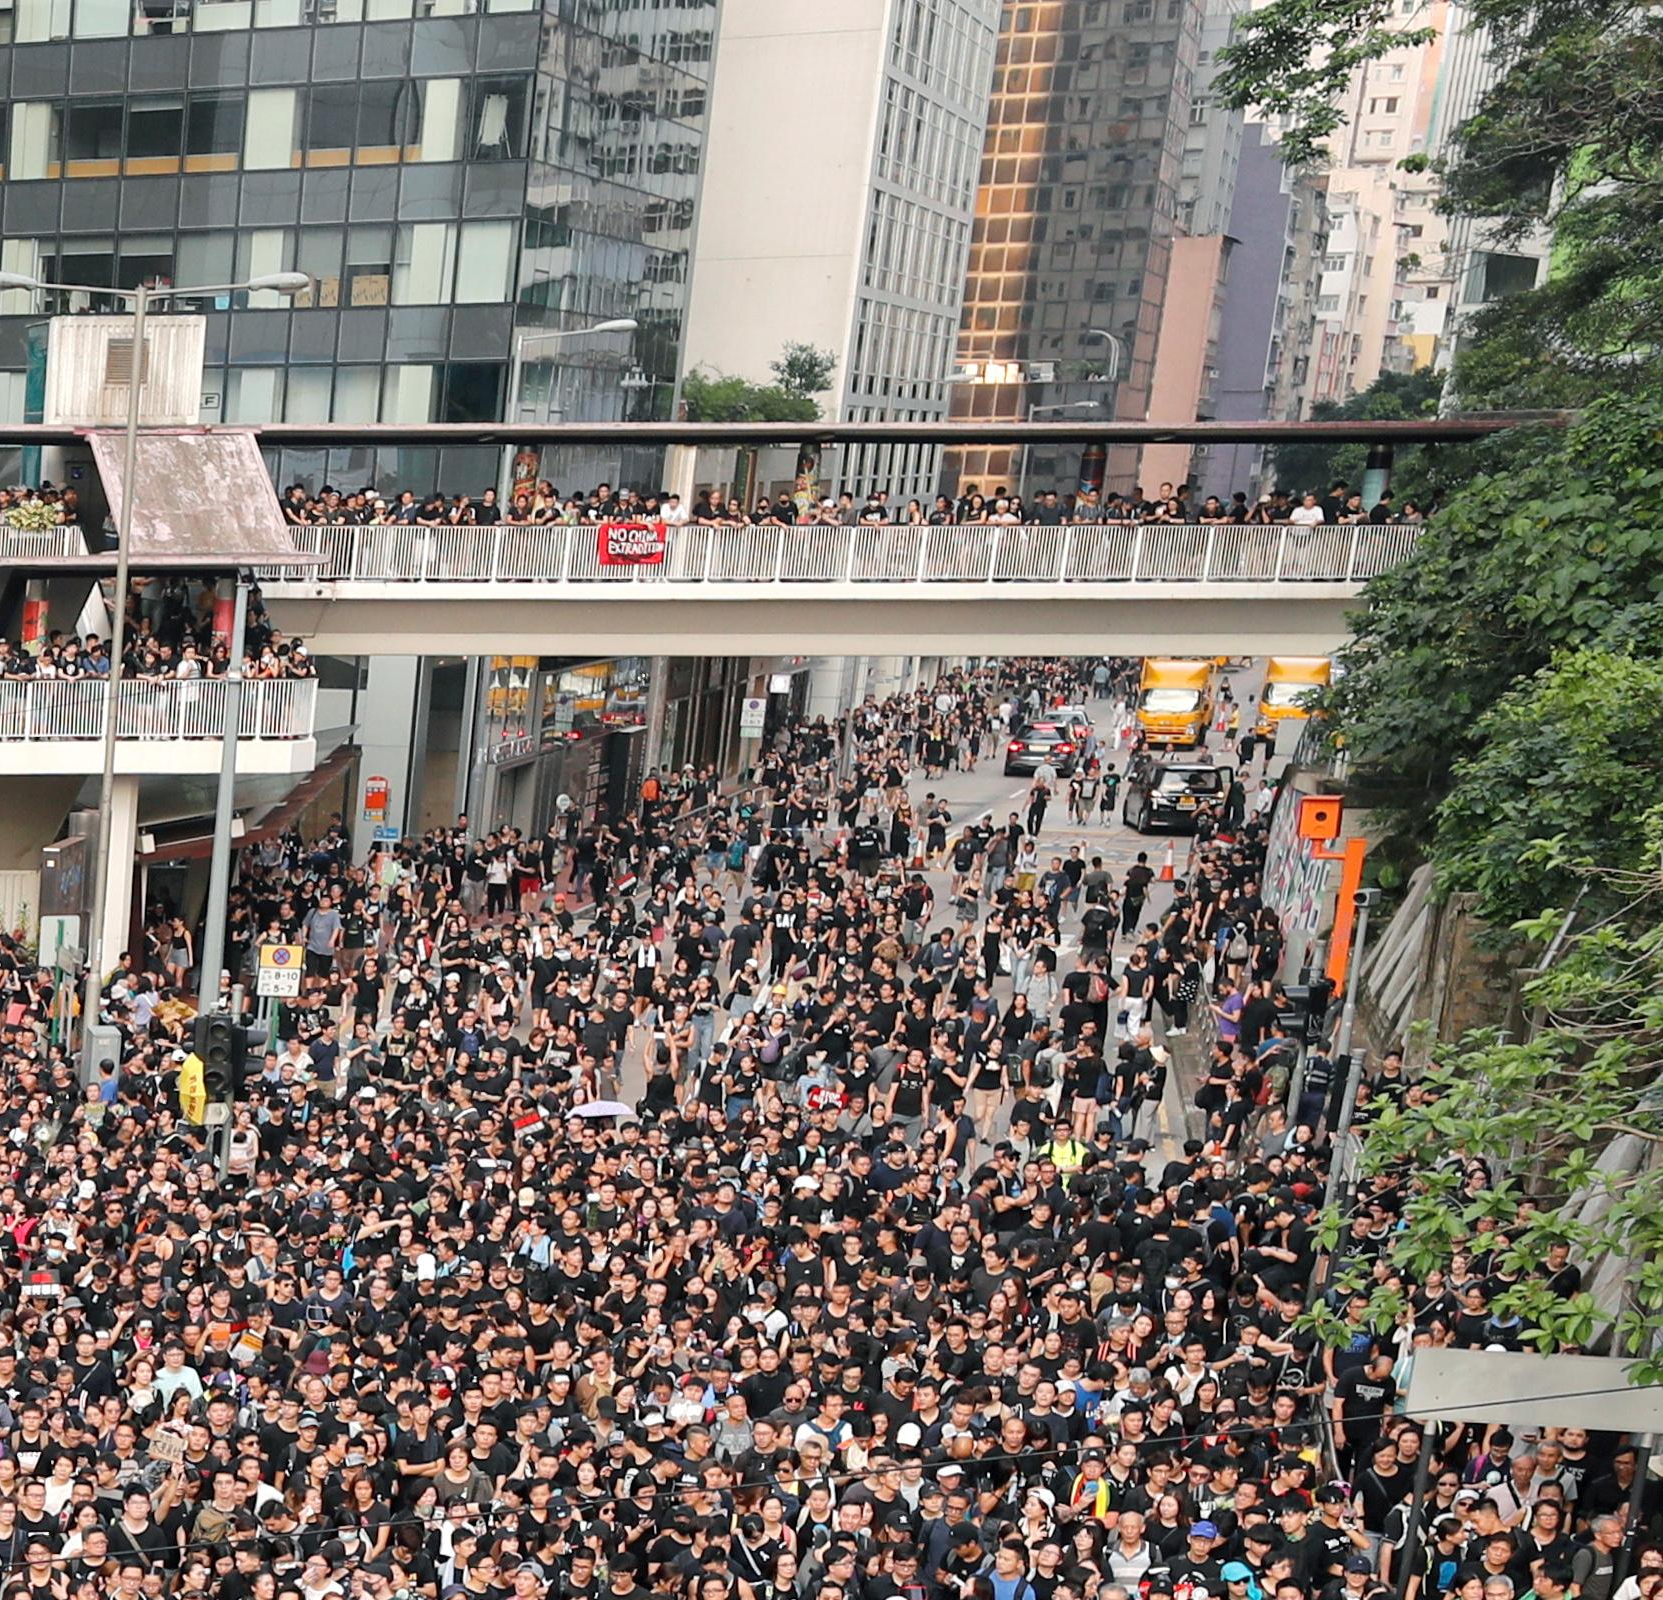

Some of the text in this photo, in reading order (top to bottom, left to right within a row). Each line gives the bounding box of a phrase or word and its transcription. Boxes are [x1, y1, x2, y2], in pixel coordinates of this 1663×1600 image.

[608, 527, 658, 543] NO CHINA
[608, 541, 665, 555] EXTRADITION
